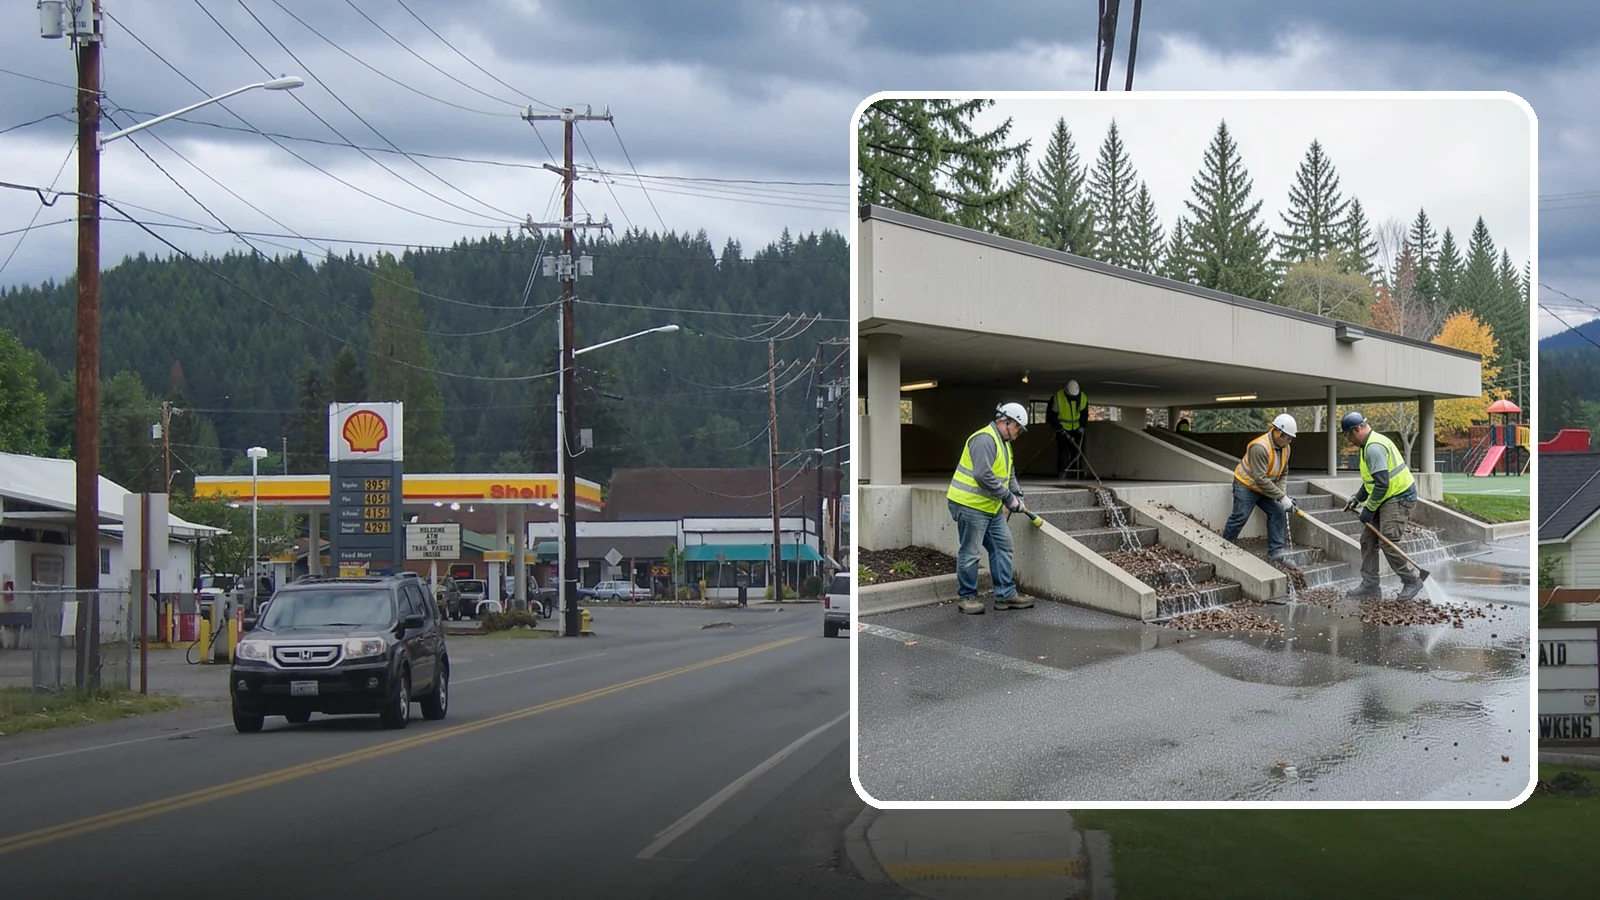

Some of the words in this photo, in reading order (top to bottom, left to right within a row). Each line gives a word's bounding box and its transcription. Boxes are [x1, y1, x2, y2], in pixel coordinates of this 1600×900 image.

[366, 480, 384, 490] 395
[490, 484, 547, 498] Shell
[366, 494, 384, 504] 405
[366, 508, 384, 518] 415
[366, 522, 384, 532] 429
[1539, 643, 1567, 665] AID
